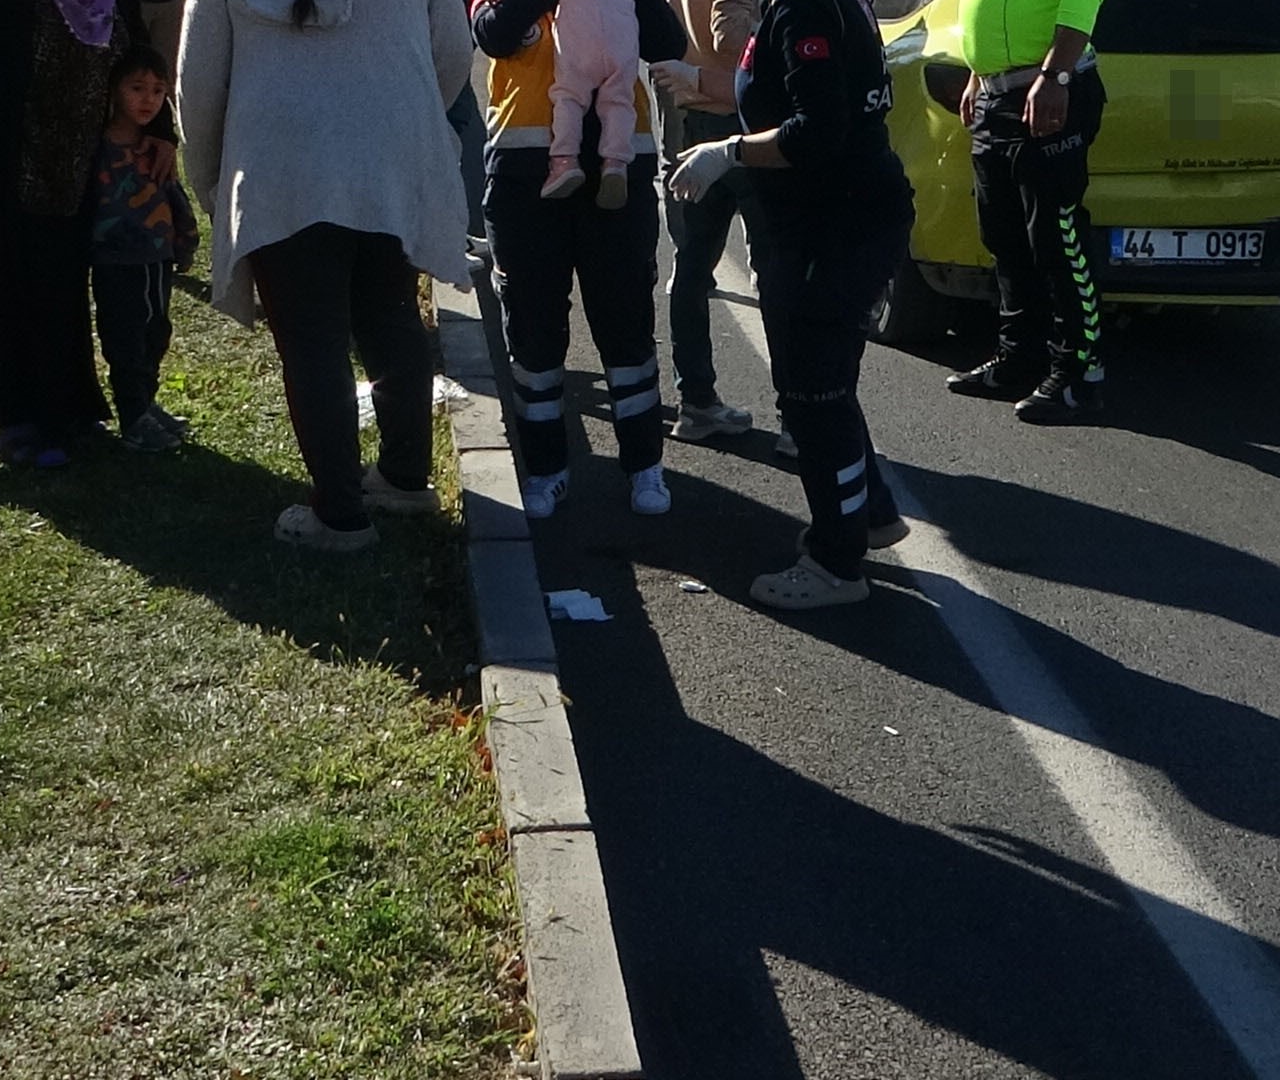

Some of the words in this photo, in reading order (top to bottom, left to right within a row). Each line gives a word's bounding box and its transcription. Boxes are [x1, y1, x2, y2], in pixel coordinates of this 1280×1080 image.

[1124, 230, 1154, 257] 44
[1172, 231, 1188, 257] T
[1206, 231, 1263, 258] 0913
